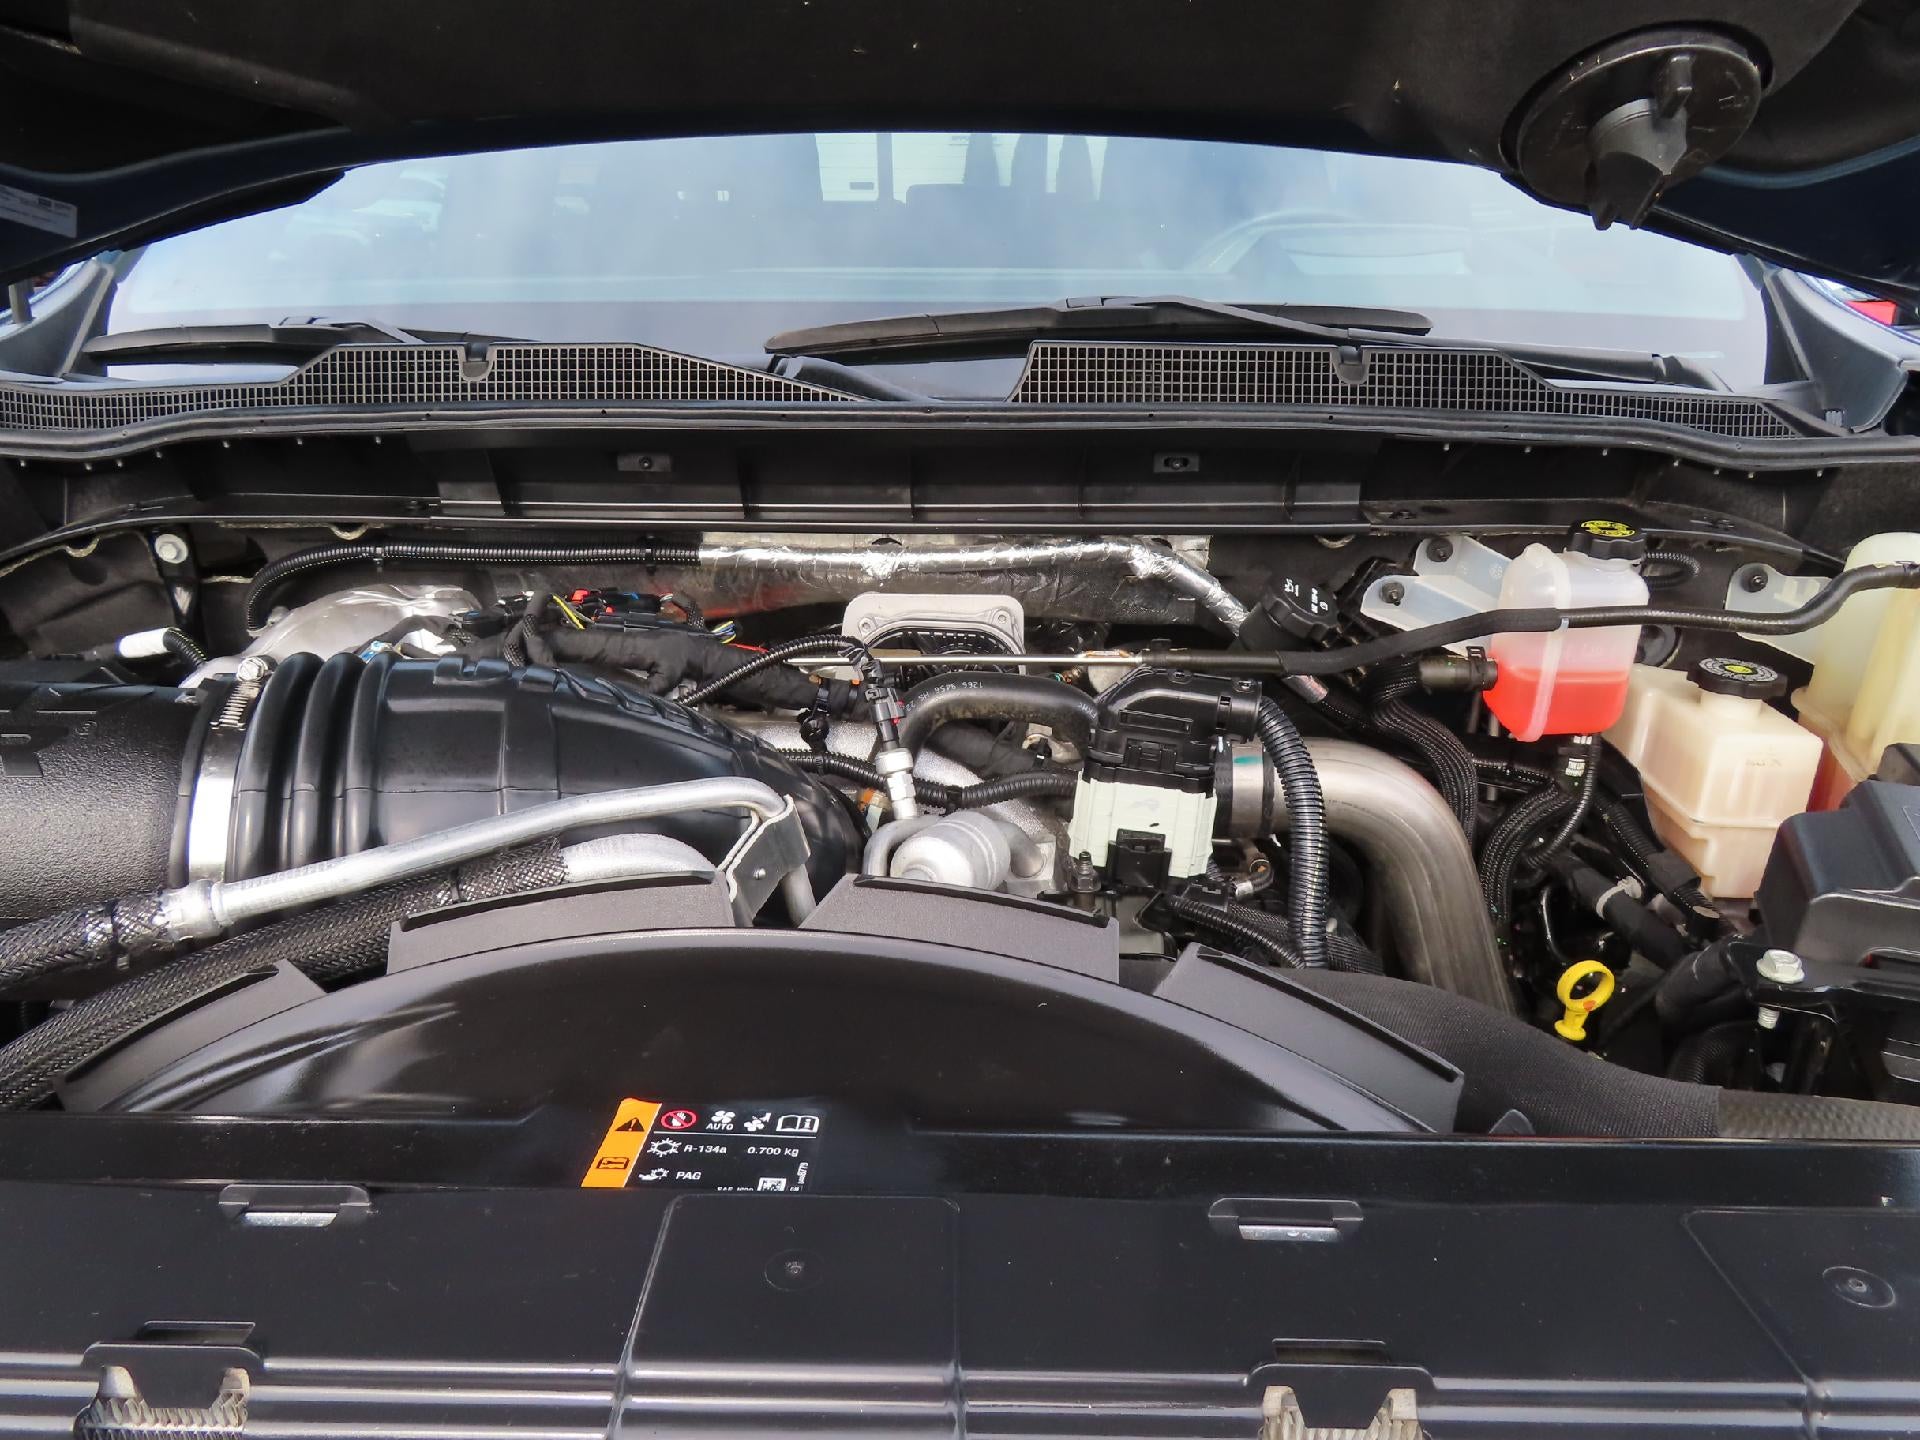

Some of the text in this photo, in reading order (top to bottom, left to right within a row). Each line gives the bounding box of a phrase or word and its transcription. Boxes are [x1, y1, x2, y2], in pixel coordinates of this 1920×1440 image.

[705, 1123, 734, 1131] AUTO
[683, 1145, 799, 1157] R-134a 0.700 kg
[675, 1171, 702, 1180] PAG
